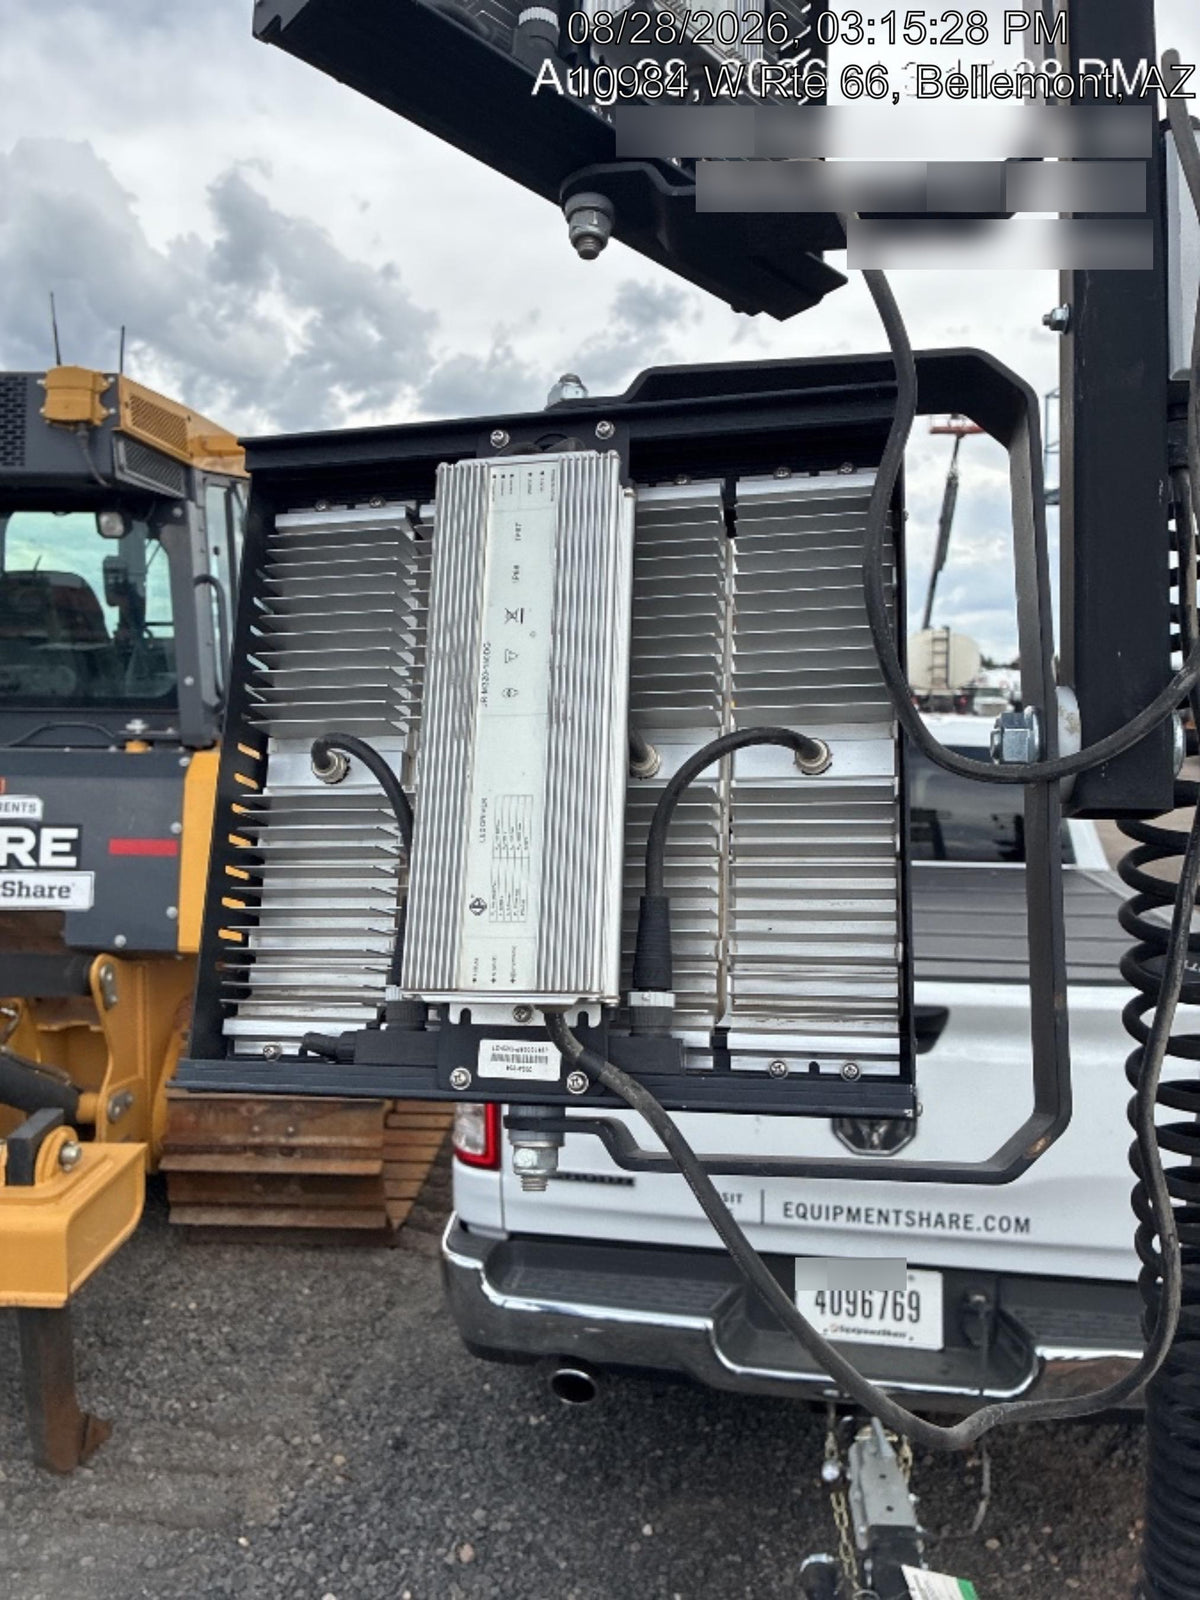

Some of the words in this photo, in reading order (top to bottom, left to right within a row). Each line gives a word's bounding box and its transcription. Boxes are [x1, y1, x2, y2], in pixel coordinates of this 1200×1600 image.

[0, 828, 78, 866] RE
[783, 1201, 1032, 1235] EQUIPMENTSHARE.COM
[815, 1290, 921, 1323] 4096769
